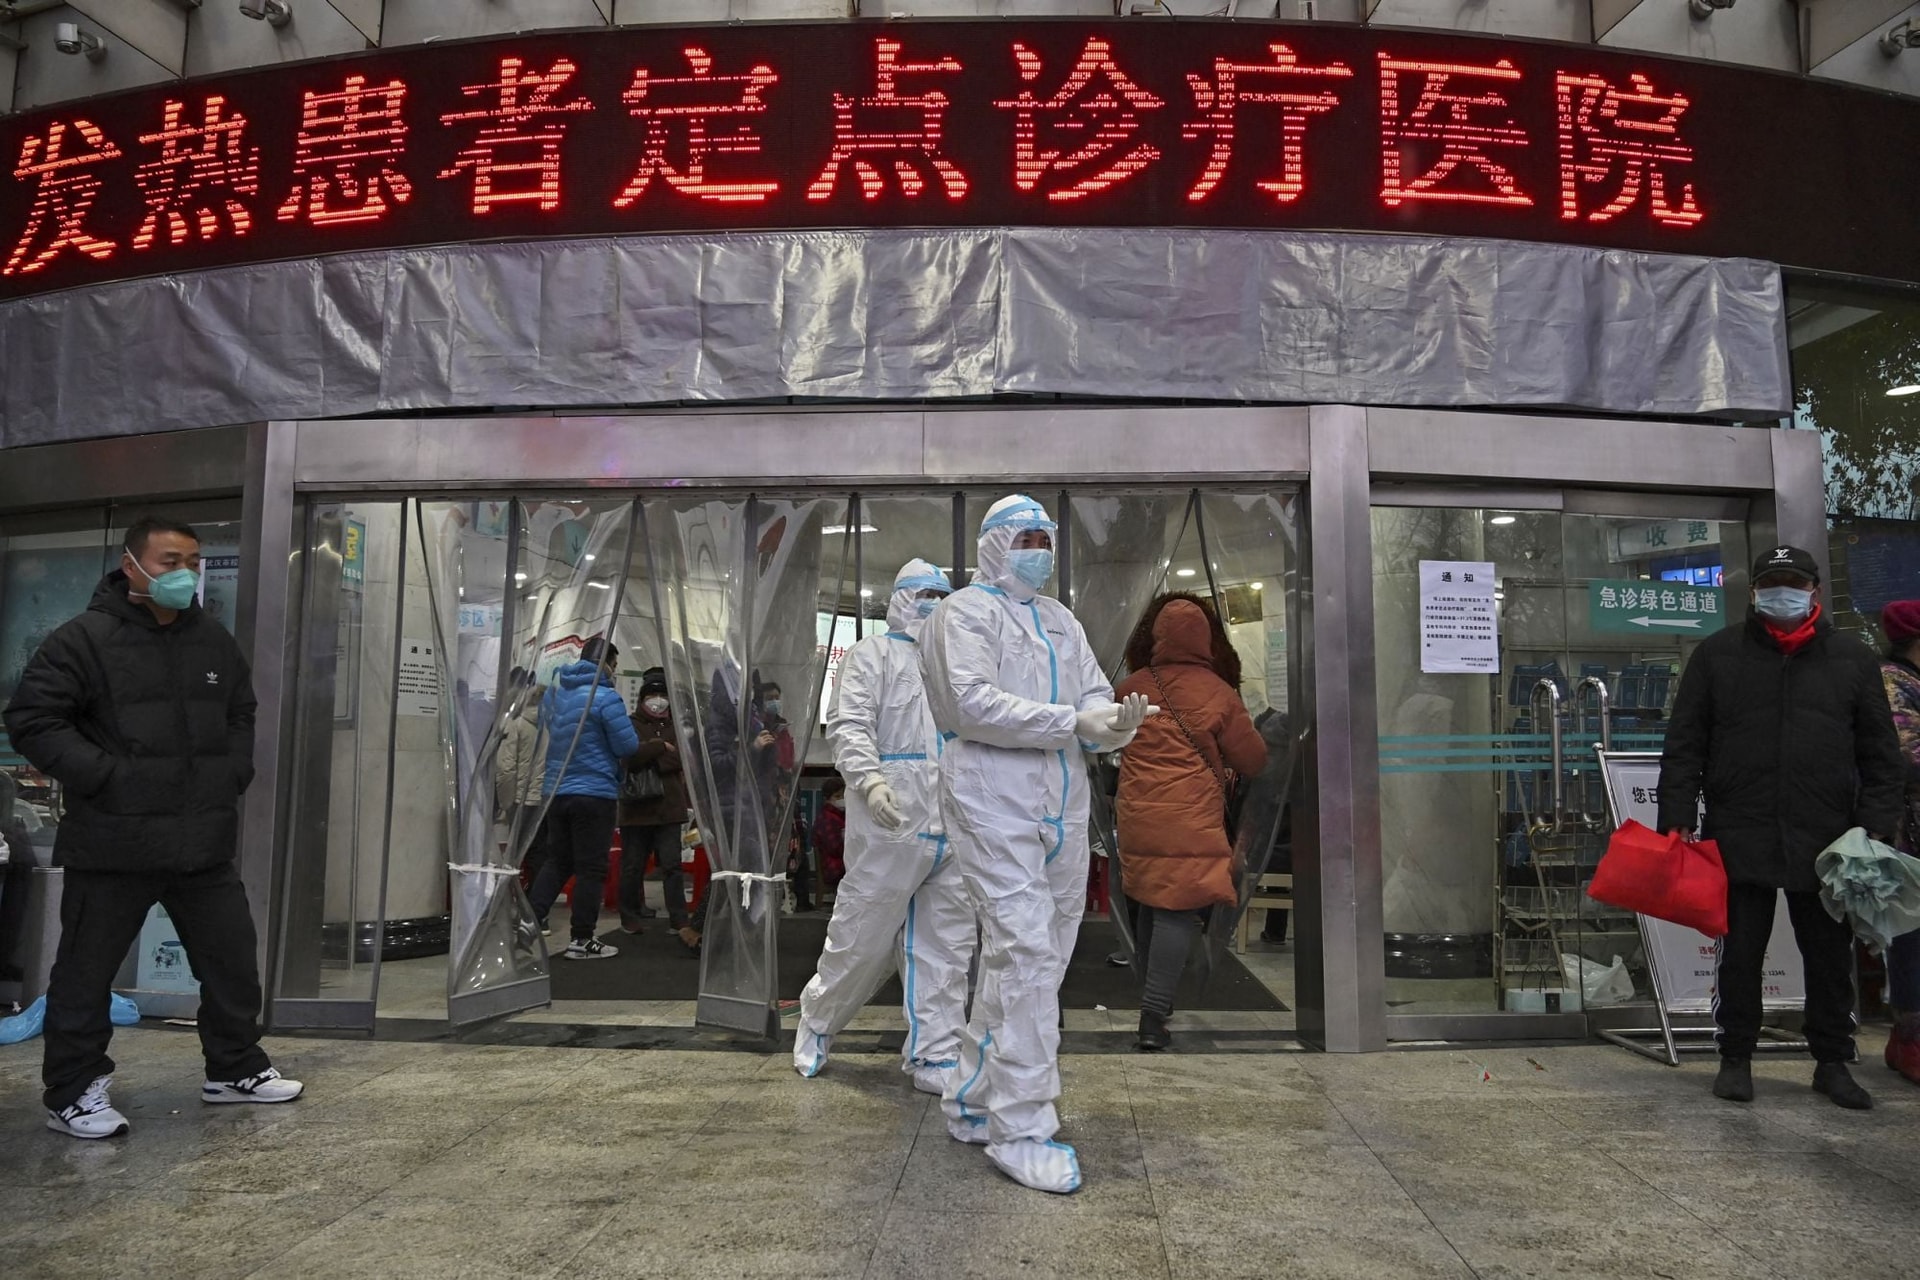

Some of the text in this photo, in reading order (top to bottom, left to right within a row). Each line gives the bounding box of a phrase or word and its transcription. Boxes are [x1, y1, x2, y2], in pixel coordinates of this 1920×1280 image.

[3, 37, 1704, 274] 发热患者定点诊疗医院
[1646, 521, 1708, 547] 收费
[1441, 572, 1474, 583] 通知
[1600, 586, 1718, 614] 急诊绿色通道
